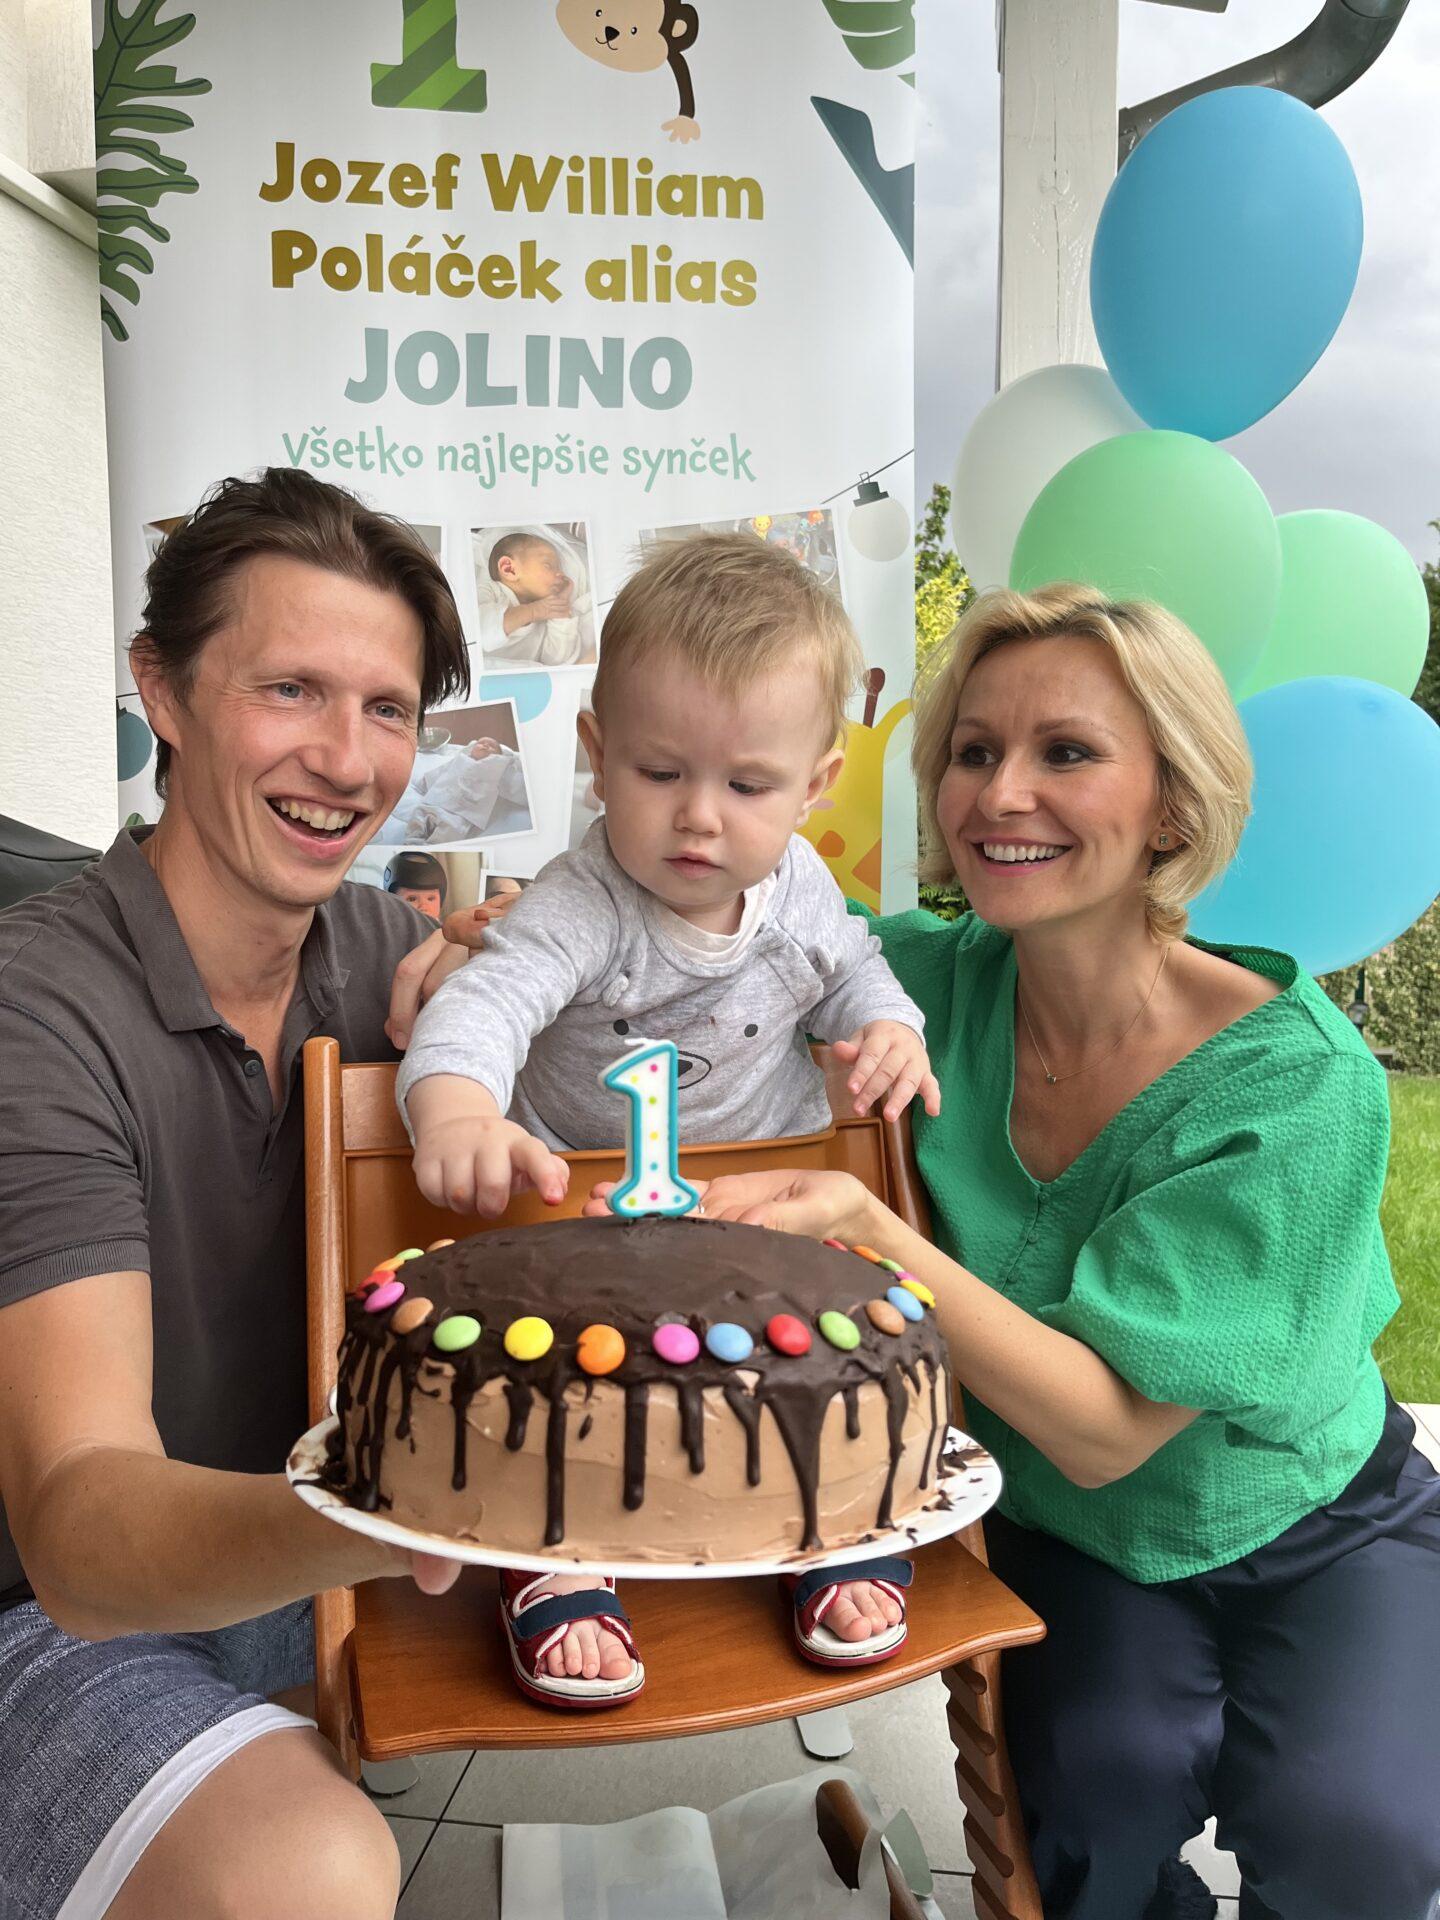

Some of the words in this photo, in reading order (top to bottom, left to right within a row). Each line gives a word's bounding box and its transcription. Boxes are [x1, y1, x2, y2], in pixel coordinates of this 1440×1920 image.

[259, 142, 461, 210] Jozef
[480, 153, 764, 220] William
[271, 229, 563, 303] Poláček
[585, 244, 758, 307] alias
[345, 328, 692, 410] JOLINO
[281, 426, 424, 477] Všetko
[438, 432, 609, 489] najlepšie
[623, 433, 757, 492] synček
[598, 1039, 700, 1218] 1
